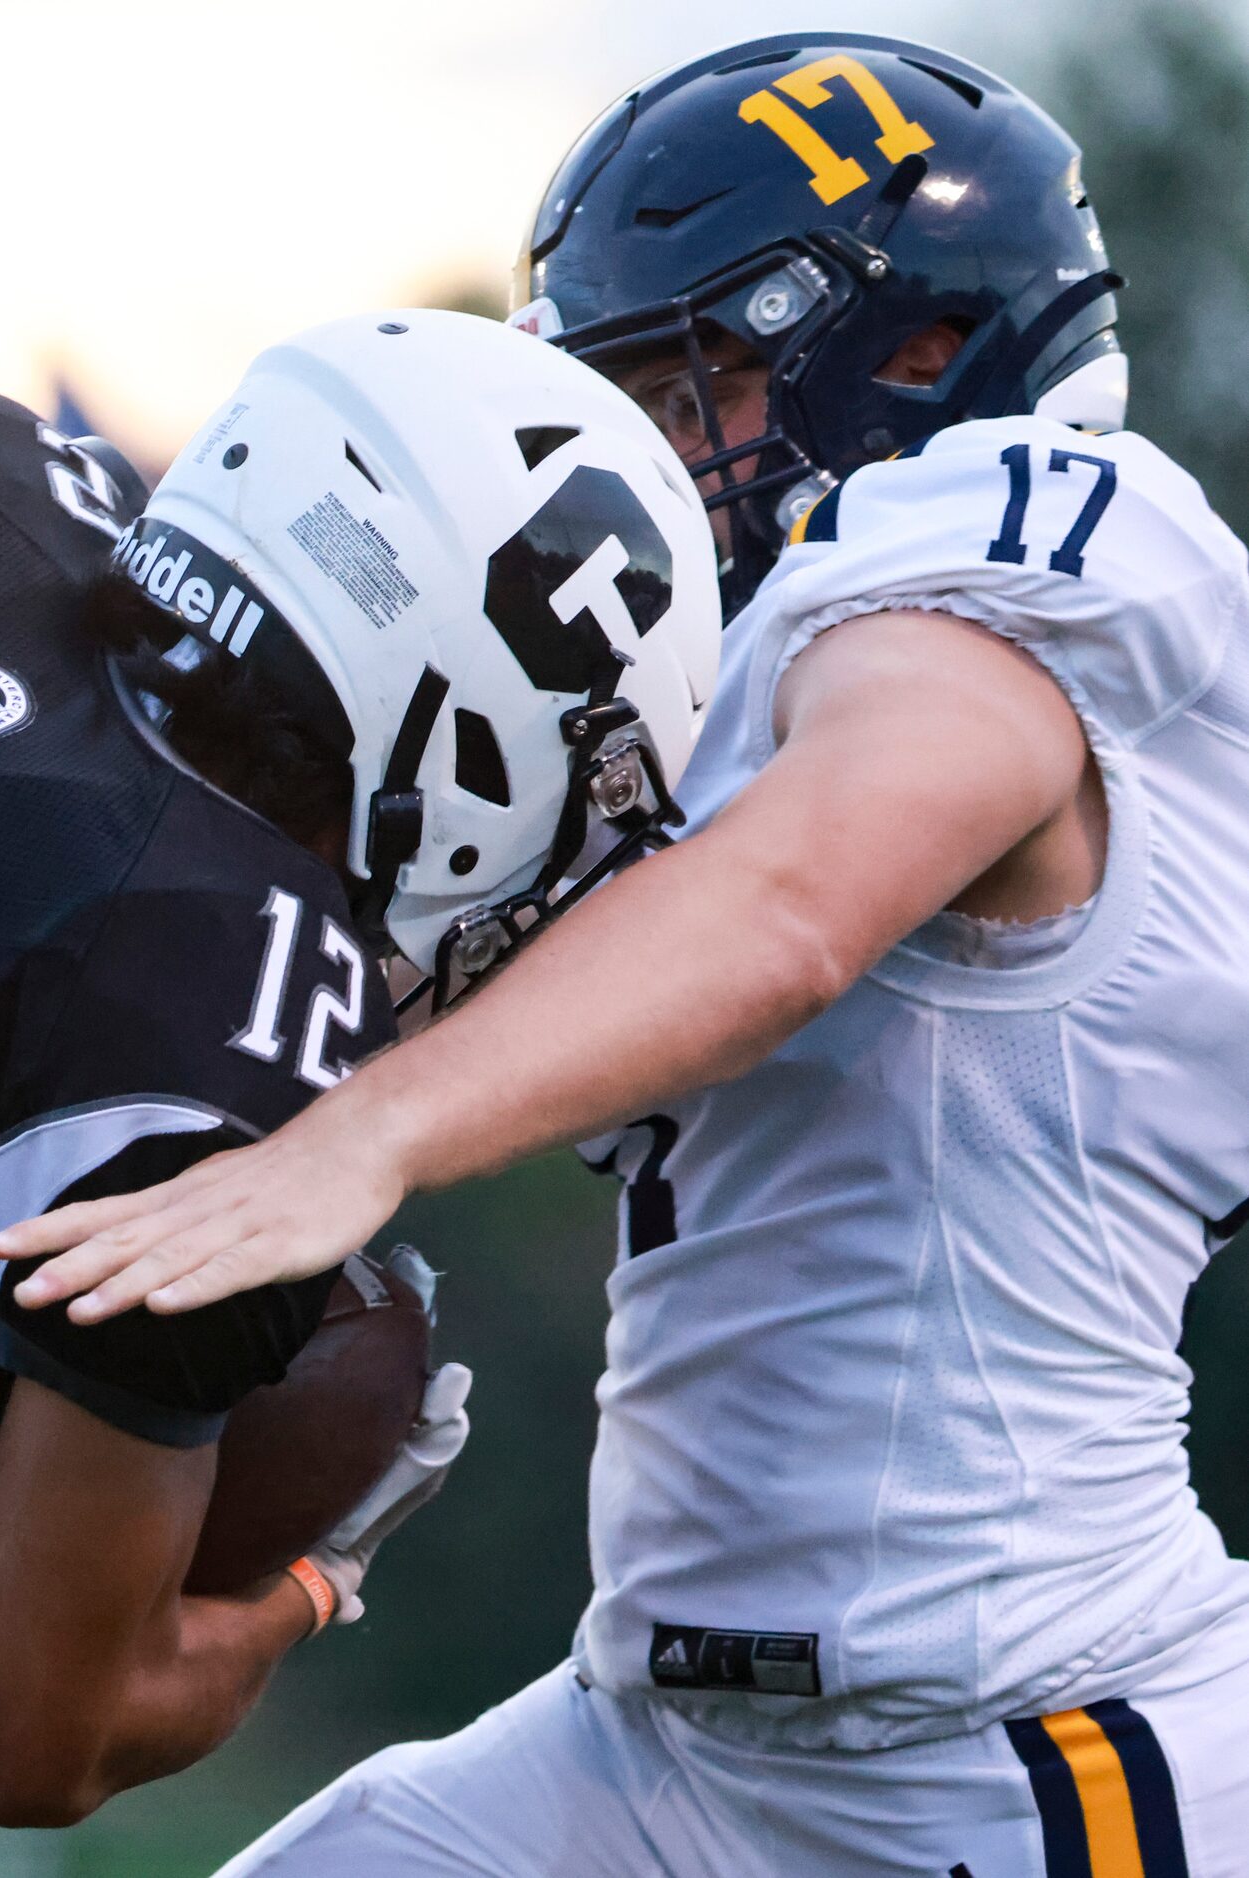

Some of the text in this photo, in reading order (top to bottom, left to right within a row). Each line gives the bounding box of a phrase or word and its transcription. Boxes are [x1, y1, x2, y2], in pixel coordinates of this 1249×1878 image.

[739, 54, 936, 206] 17
[362, 517, 399, 561] WARNING
[987, 443, 1118, 579] 17
[226, 886, 367, 1091] 12
